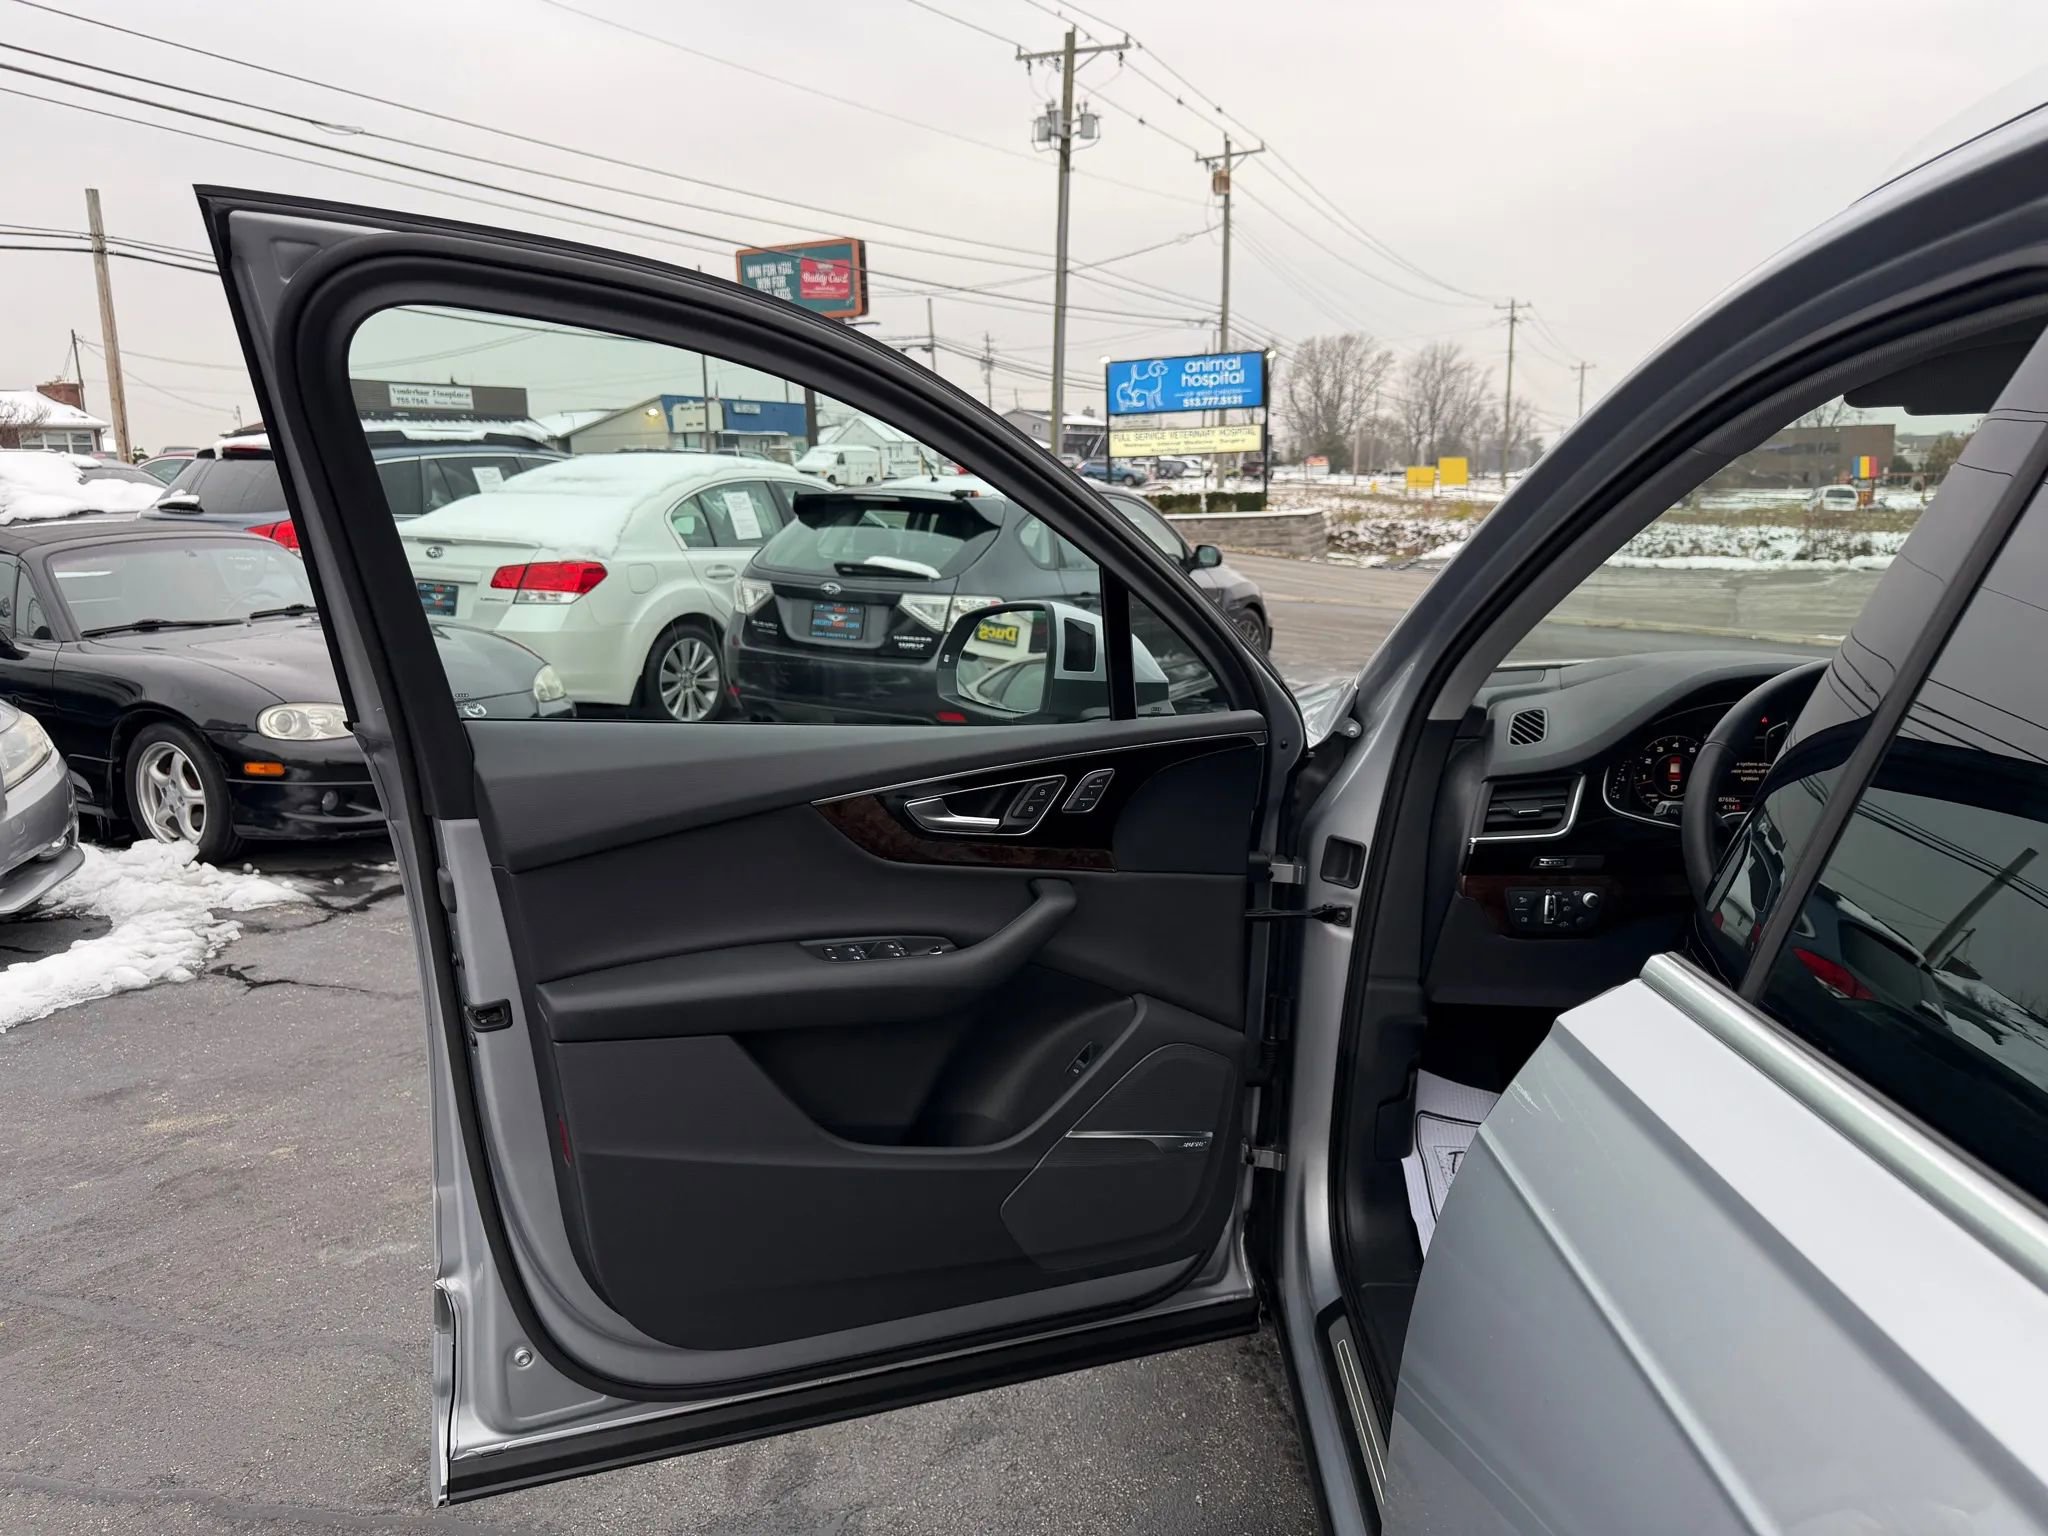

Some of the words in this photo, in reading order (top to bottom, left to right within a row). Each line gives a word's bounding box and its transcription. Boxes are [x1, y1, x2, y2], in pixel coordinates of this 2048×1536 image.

[746, 264, 762, 279] WIN
[762, 263, 777, 277] FOR
[771, 275, 787, 289] FOR
[1184, 356, 1242, 374] animal
[1180, 369, 1246, 388] hospital
[1113, 432, 1132, 443] FULL
[1135, 430, 1166, 442] SERVICE
[1169, 428, 1216, 441] VETERINARY
[1219, 426, 1258, 438] HOSPITAL
